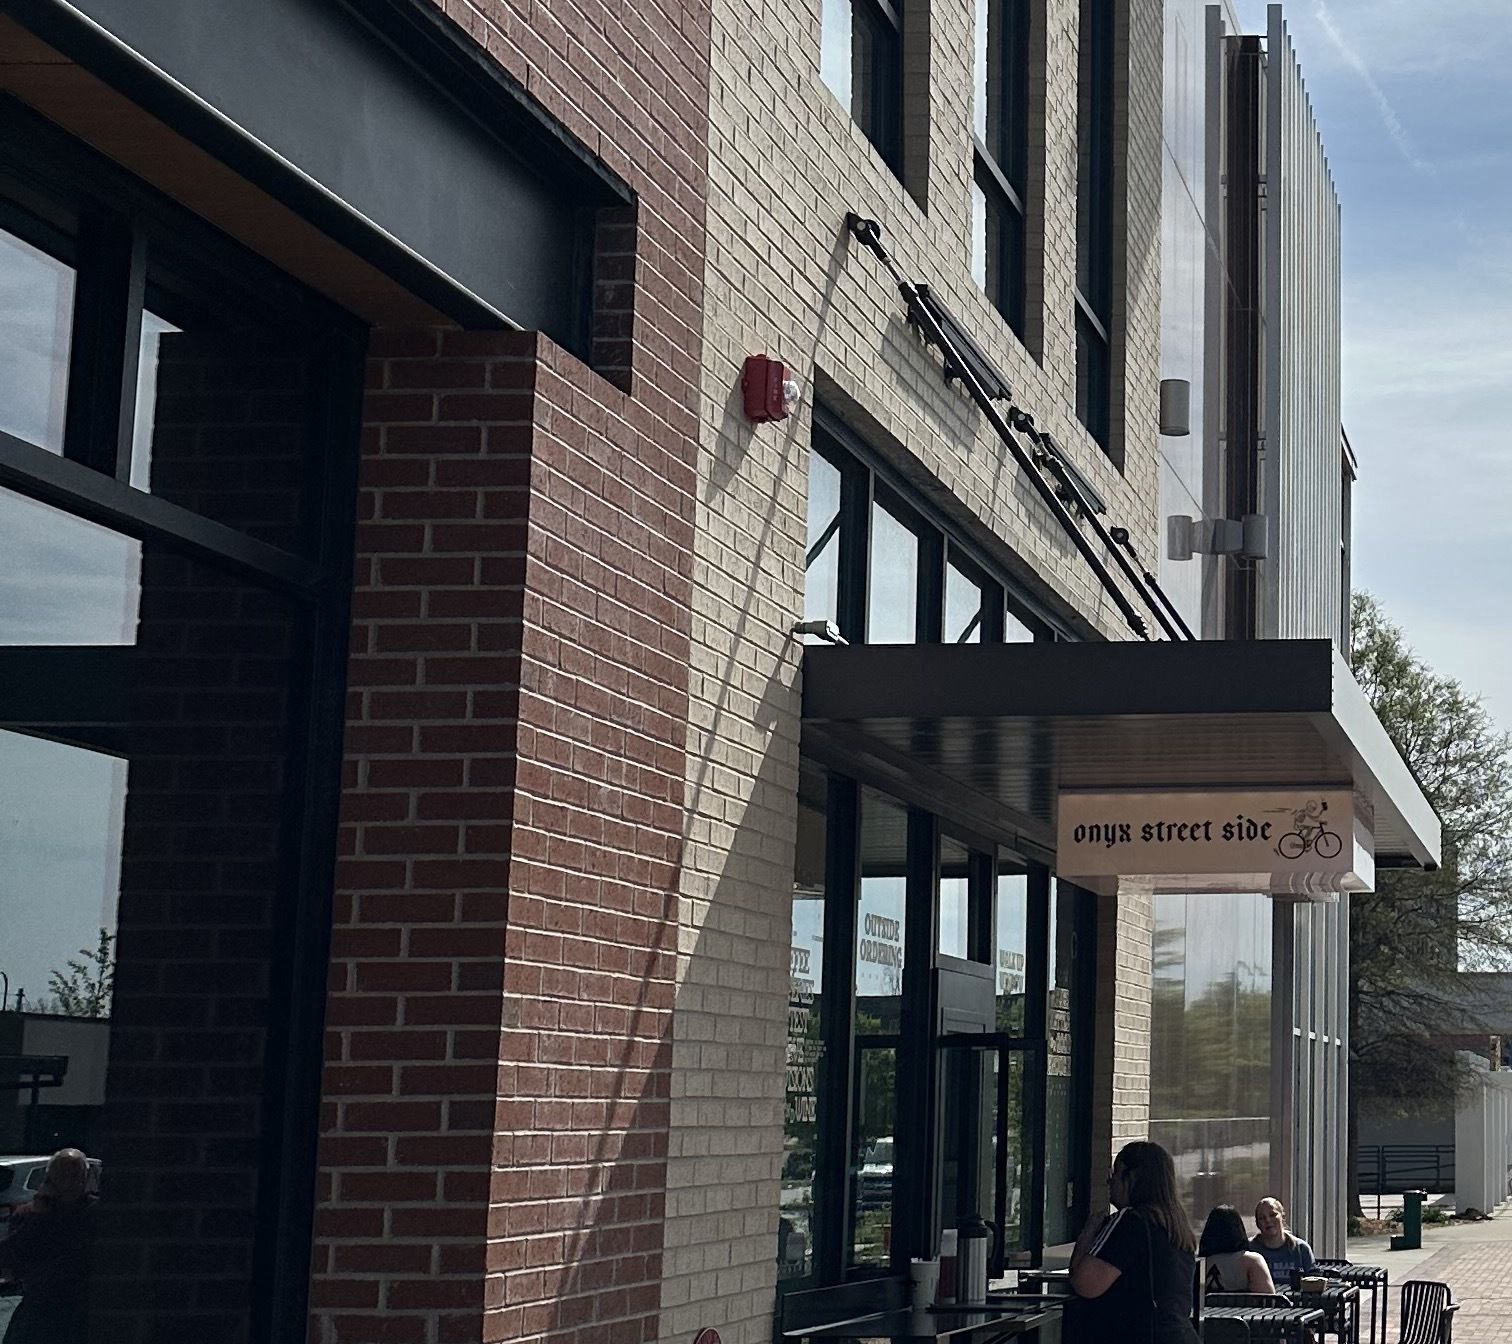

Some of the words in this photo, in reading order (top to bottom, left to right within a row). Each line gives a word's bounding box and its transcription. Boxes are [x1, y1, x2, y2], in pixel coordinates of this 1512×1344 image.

[1073, 823, 1132, 848] onyx
[1140, 819, 1213, 843] street
[1221, 814, 1273, 842] side
